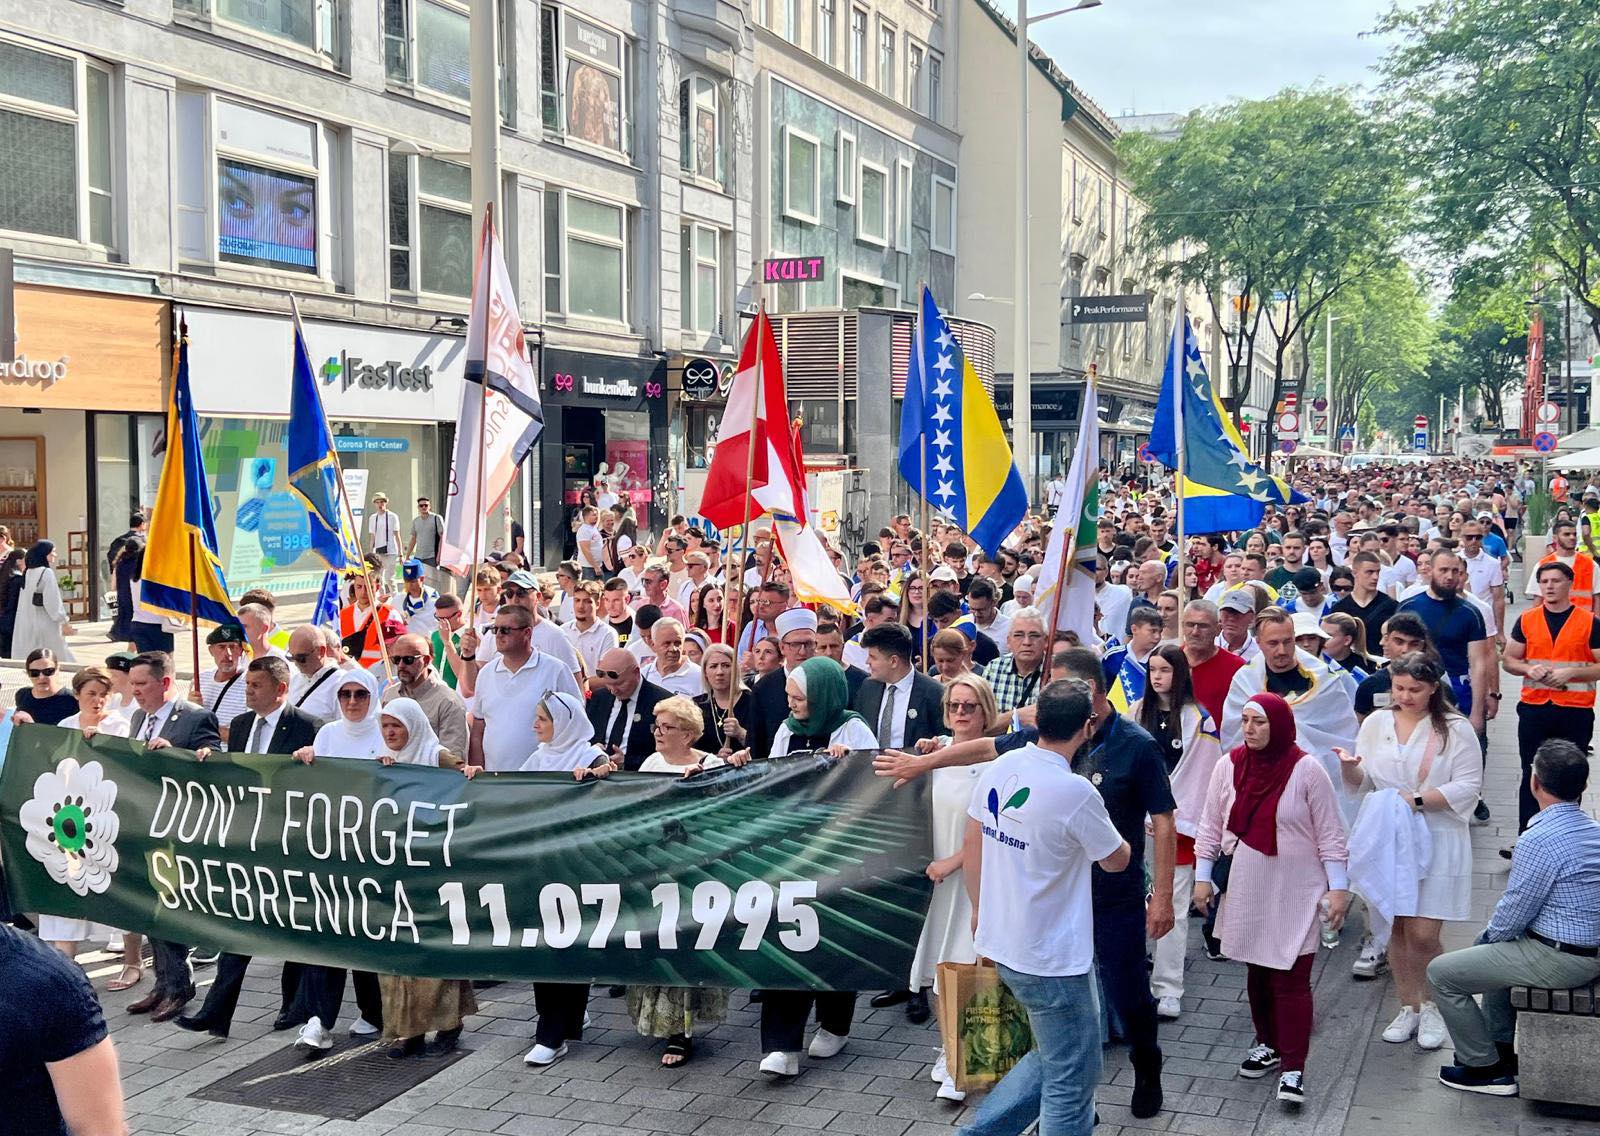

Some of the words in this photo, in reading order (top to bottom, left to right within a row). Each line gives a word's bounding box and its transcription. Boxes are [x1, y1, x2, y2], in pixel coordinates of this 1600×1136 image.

[766, 260, 821, 280] KULT
[348, 357, 433, 393] FasTest
[338, 439, 363, 449] Corona
[150, 776, 272, 851] DON'T
[281, 790, 469, 867] FORGET
[152, 851, 420, 944] SREBRENICA
[438, 880, 820, 952] 11.07.1995
